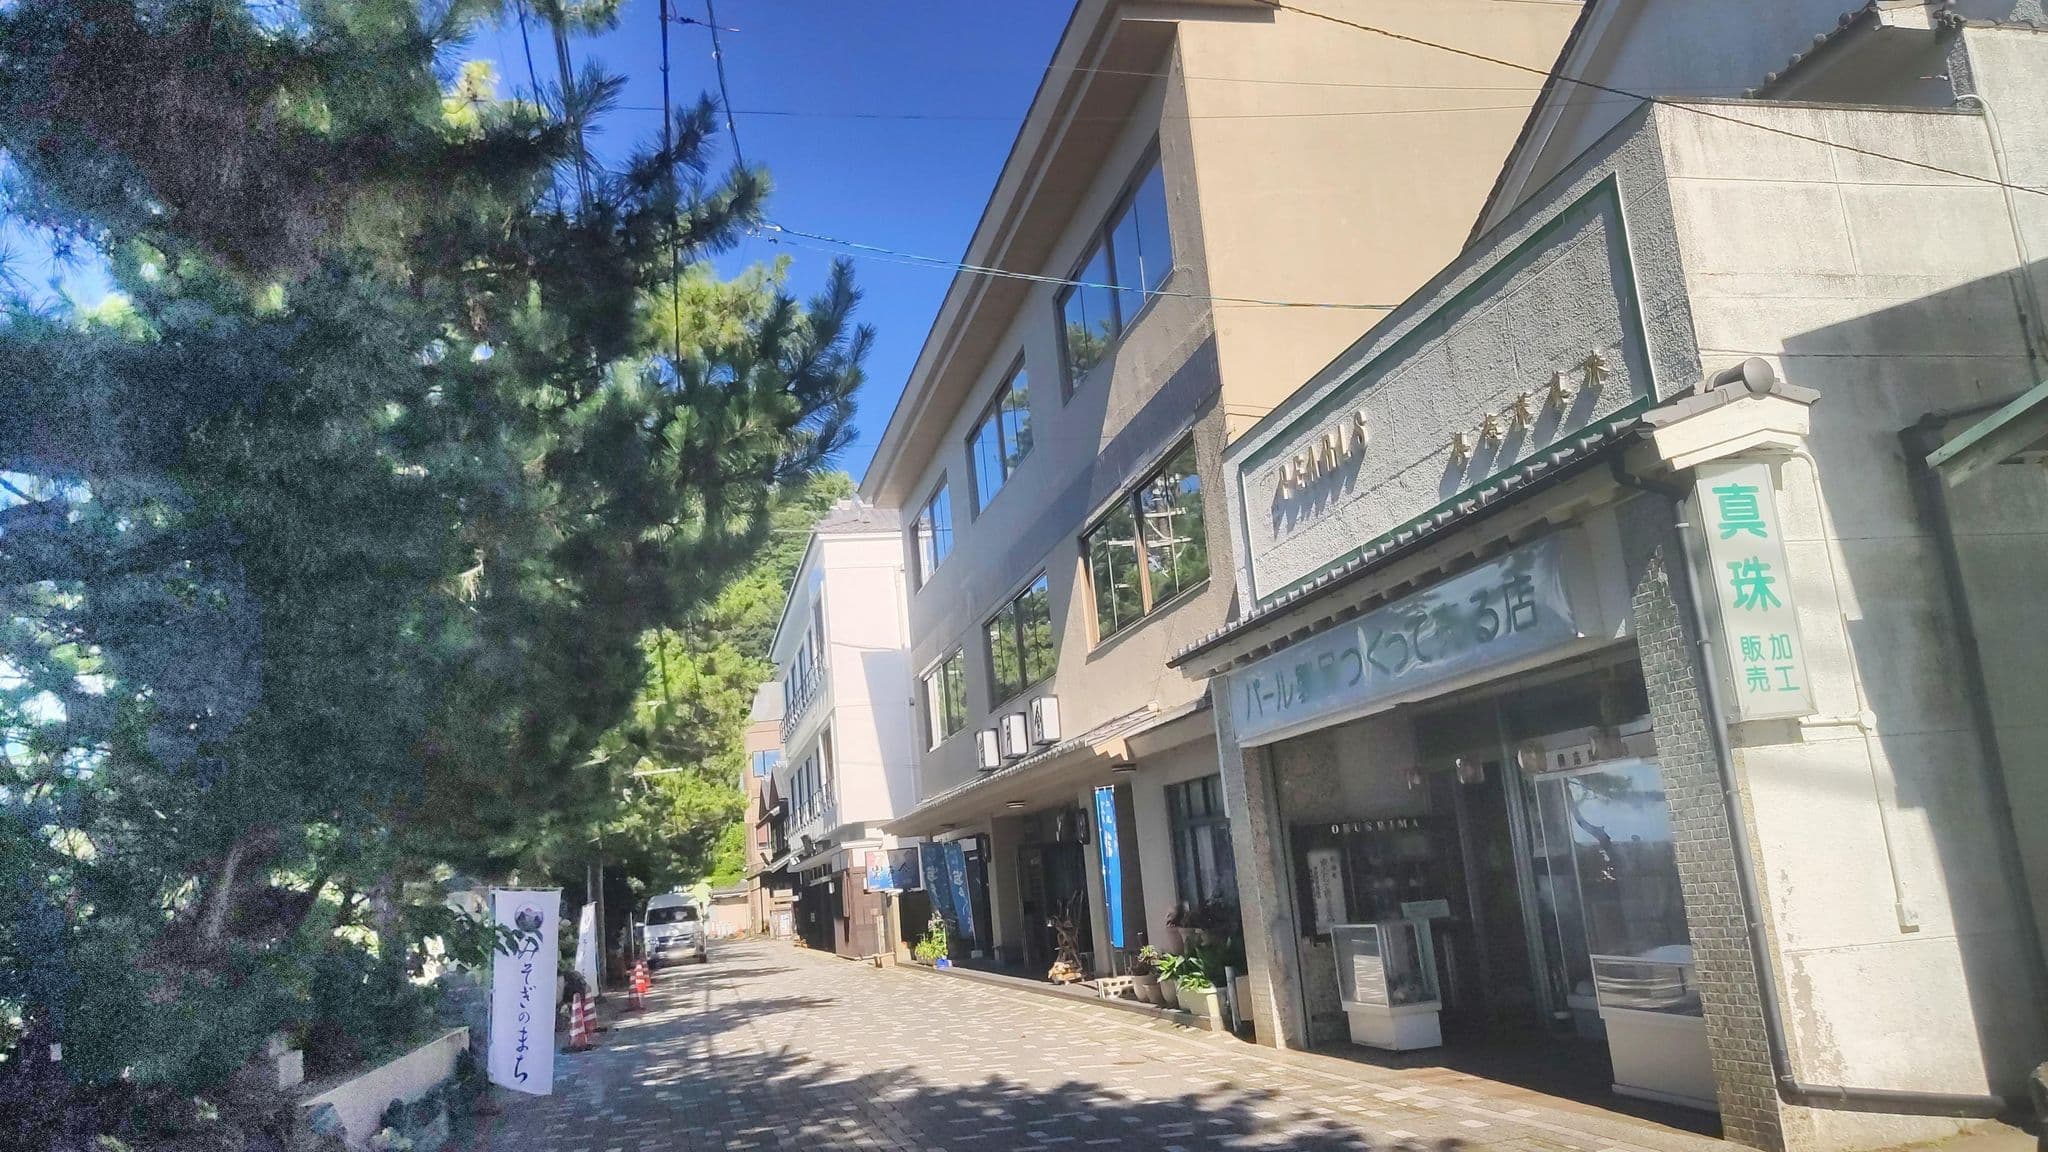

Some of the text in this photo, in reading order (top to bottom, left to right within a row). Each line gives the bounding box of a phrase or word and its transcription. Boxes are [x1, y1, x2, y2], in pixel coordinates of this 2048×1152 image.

[1279, 411, 1369, 500] PEARLS
[1711, 483, 1782, 612] 真珠
[1740, 636, 1771, 693] 販売
[1769, 633, 1801, 692] 加工
[514, 934, 540, 1084] みそぎのまち
